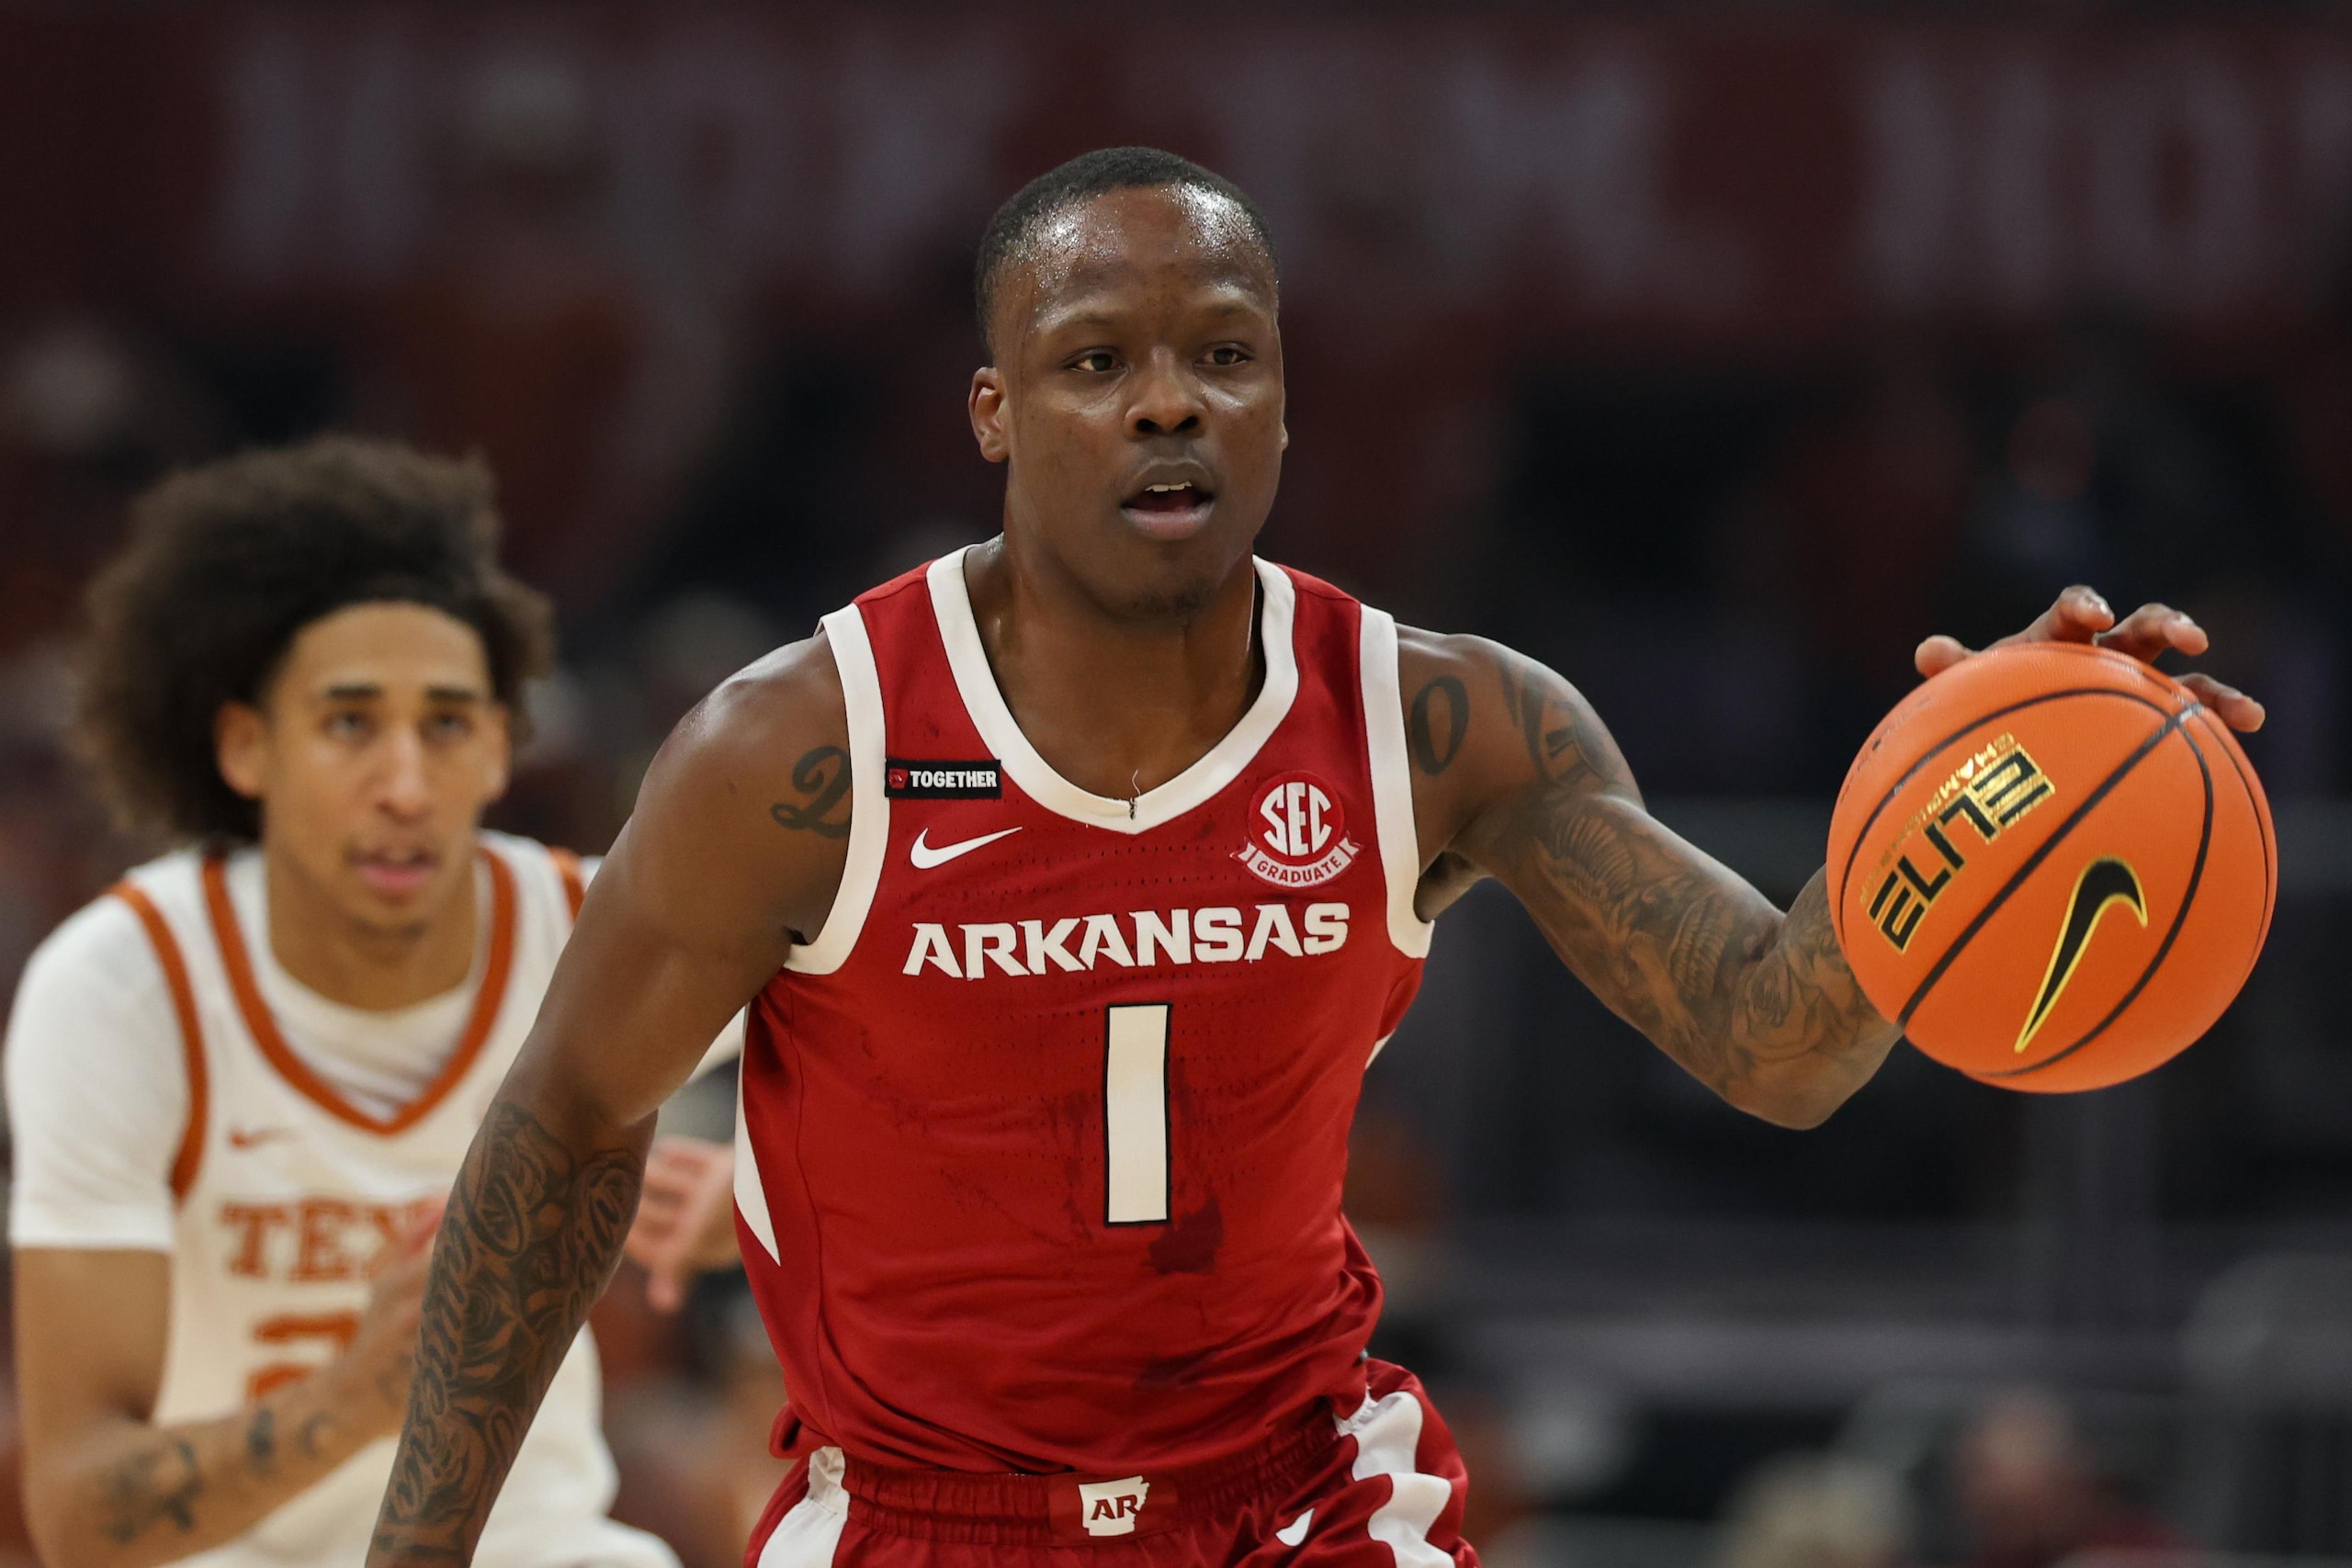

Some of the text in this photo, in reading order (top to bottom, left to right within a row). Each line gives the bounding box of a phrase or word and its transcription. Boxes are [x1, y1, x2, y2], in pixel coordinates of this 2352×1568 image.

[909, 770, 998, 789] TOGETHER
[1260, 781, 1333, 856] SEC
[1868, 743, 2056, 955] ELITE
[1256, 856, 1341, 884] GRADUATE
[902, 902, 1351, 981] ARKANSAS
[1105, 1002, 1172, 1228] 1
[220, 1197, 435, 1281] TEX
[1091, 1494, 1140, 1521] AR
